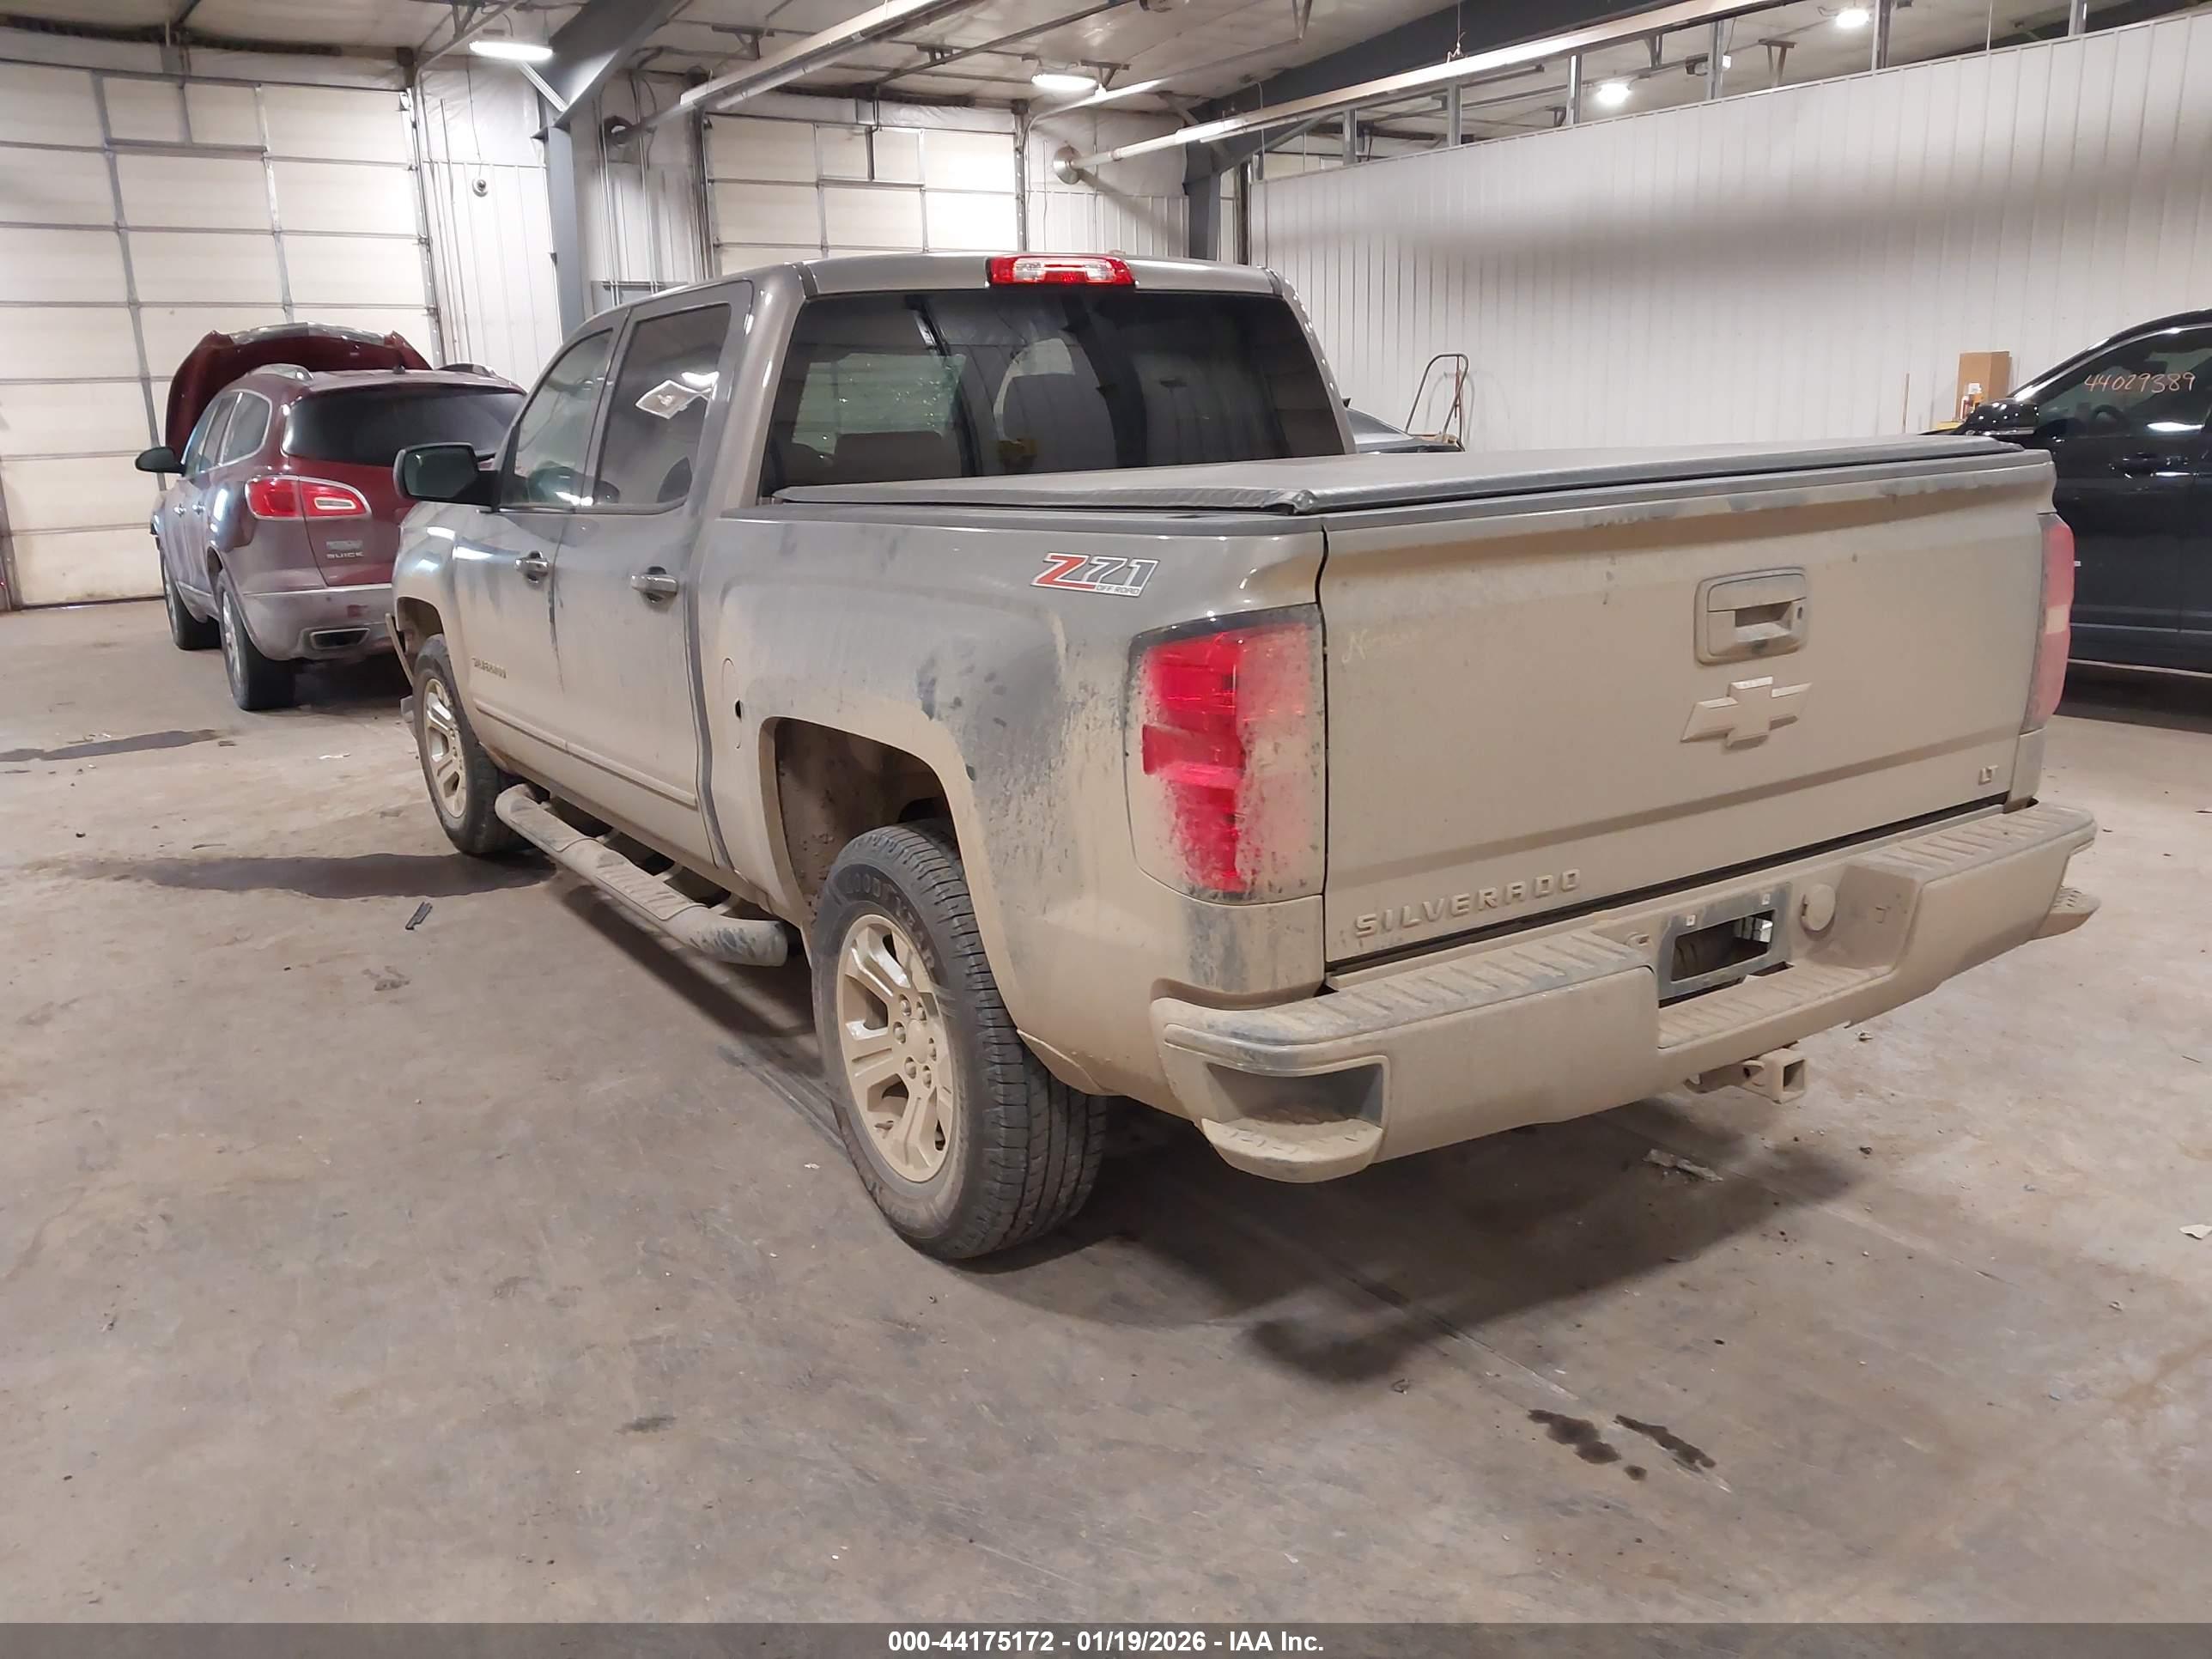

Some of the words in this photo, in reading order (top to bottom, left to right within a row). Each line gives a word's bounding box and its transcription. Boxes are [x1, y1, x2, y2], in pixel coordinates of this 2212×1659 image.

[2084, 371, 2196, 393] 44029389
[1030, 552, 1160, 597] Z71
[1115, 586, 1140, 595] ROAD
[1978, 764, 1999, 786] LT
[1354, 868, 1581, 939] SILVERADO
